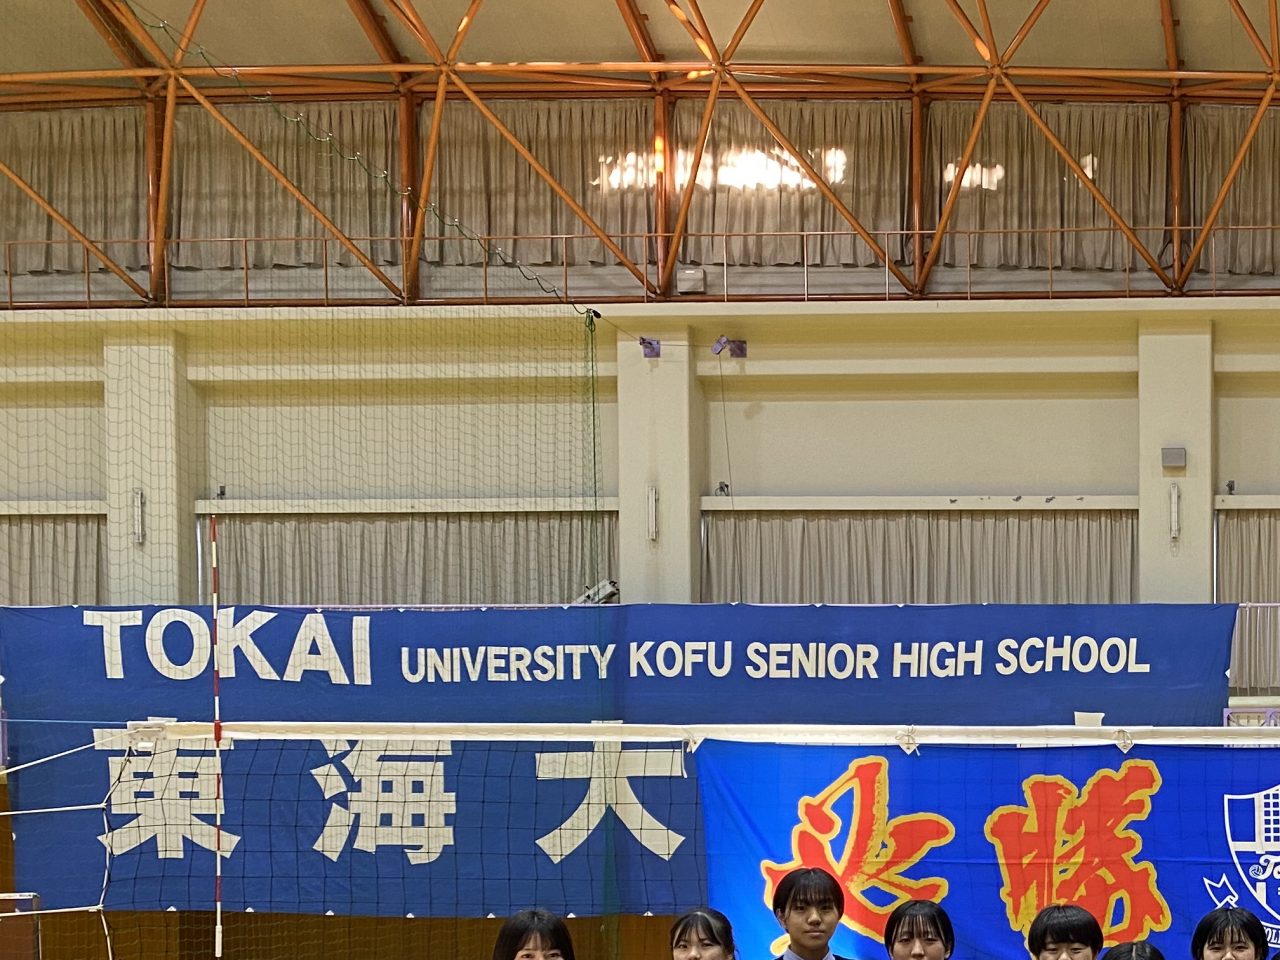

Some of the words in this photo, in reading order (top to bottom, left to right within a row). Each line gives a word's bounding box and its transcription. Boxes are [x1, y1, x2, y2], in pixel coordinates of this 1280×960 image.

[83, 607, 372, 686] TOKAI
[401, 643, 617, 684] UNIVERSITY
[629, 640, 733, 680] KOFU
[745, 641, 879, 680] SENIOR
[892, 639, 983, 679] HIGH
[995, 635, 1151, 676] SCHOOL
